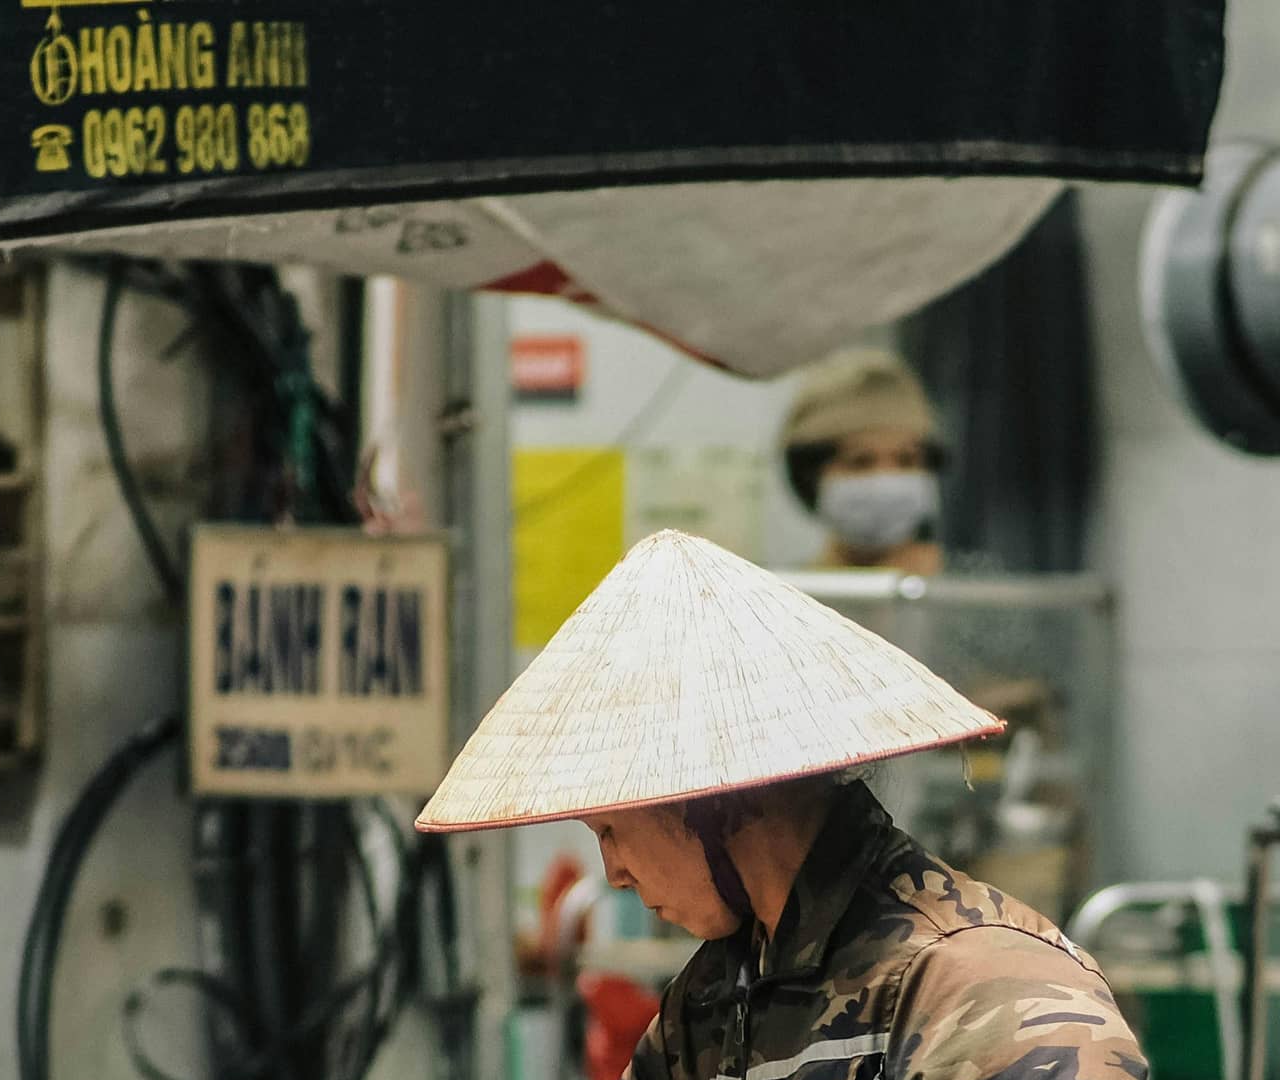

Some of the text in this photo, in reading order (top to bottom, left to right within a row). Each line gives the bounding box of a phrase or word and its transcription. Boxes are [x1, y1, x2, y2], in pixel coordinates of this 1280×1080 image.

[79, 9, 215, 95] HOÀNG
[226, 21, 308, 88] ANH
[82, 105, 167, 178] 0962
[215, 553, 423, 696] BÁNH RÁN
